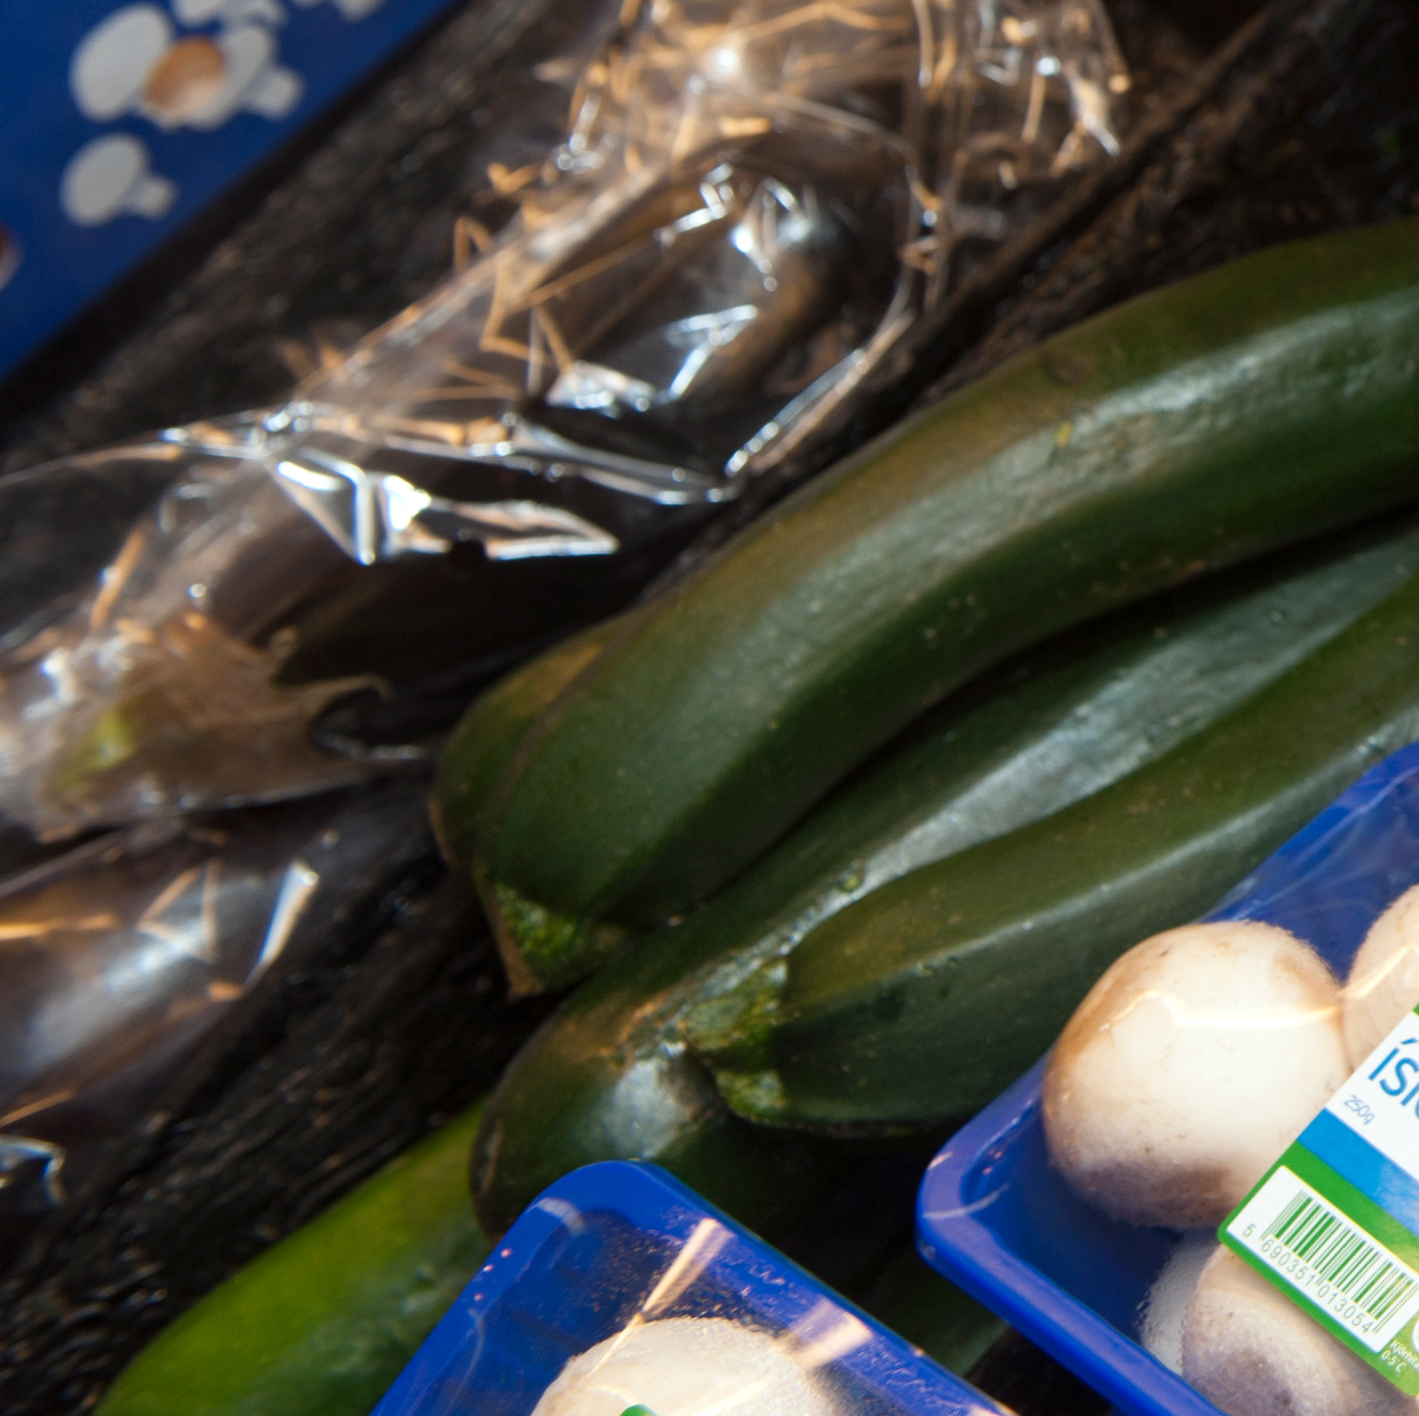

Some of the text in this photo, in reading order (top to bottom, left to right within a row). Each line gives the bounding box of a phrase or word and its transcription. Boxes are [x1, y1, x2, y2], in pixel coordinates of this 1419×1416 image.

[1343, 1094, 1375, 1125] 250g
[1261, 1238, 1316, 1287] 690351
[1317, 1284, 1374, 1334] 013054
